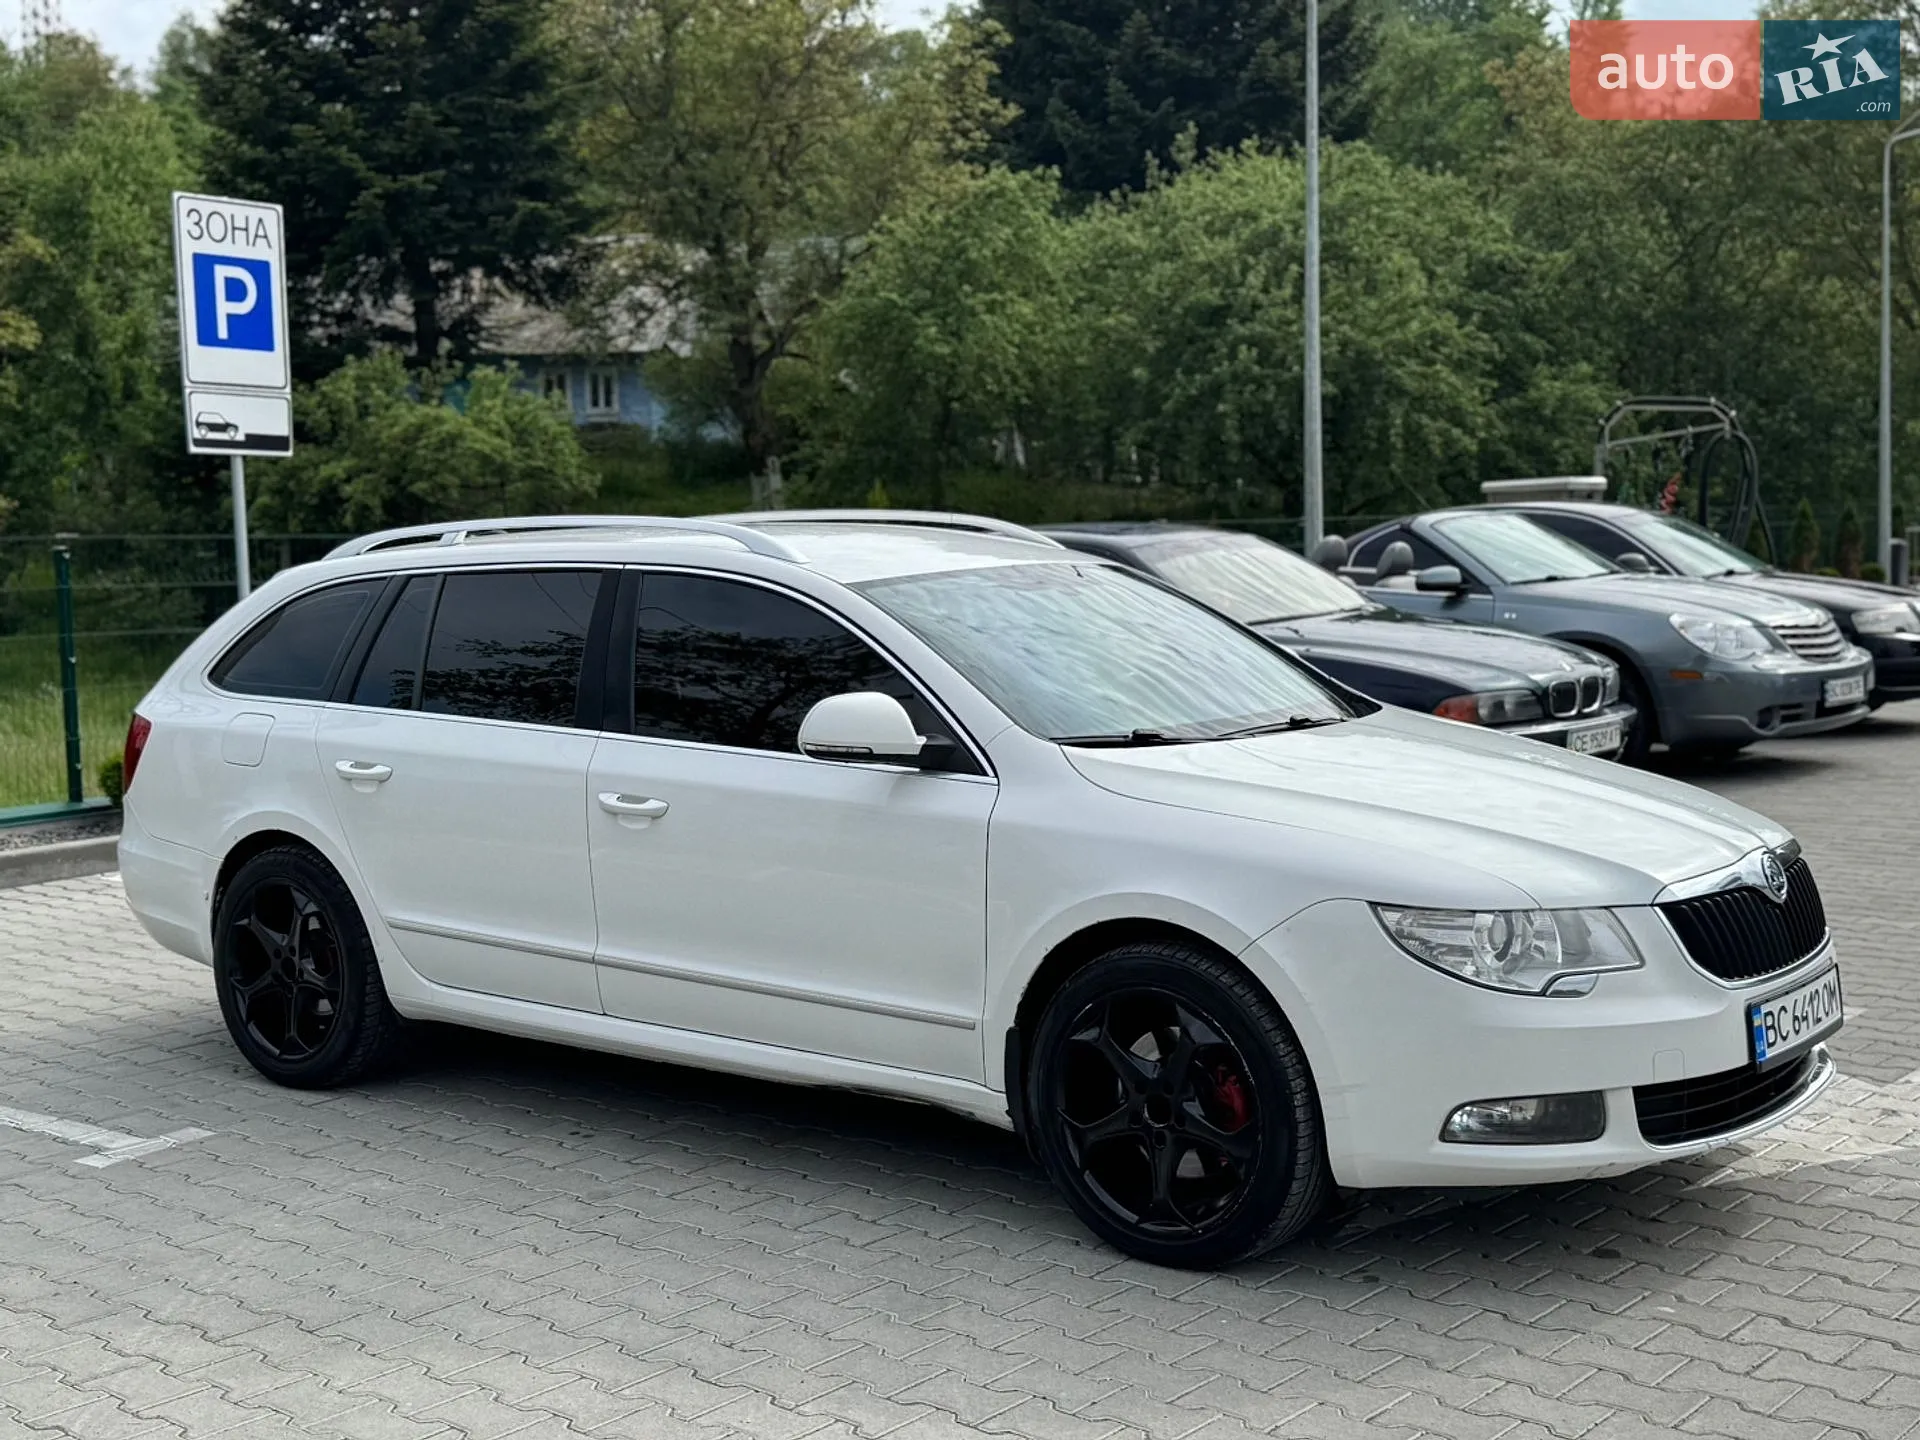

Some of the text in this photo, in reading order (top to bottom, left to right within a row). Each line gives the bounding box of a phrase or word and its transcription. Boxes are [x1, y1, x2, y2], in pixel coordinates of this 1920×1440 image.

[186, 208, 272, 249] ЗОНА
[213, 263, 257, 340] P
[1764, 1004, 1791, 1049] BC
[1791, 988, 1822, 1036] 6412
